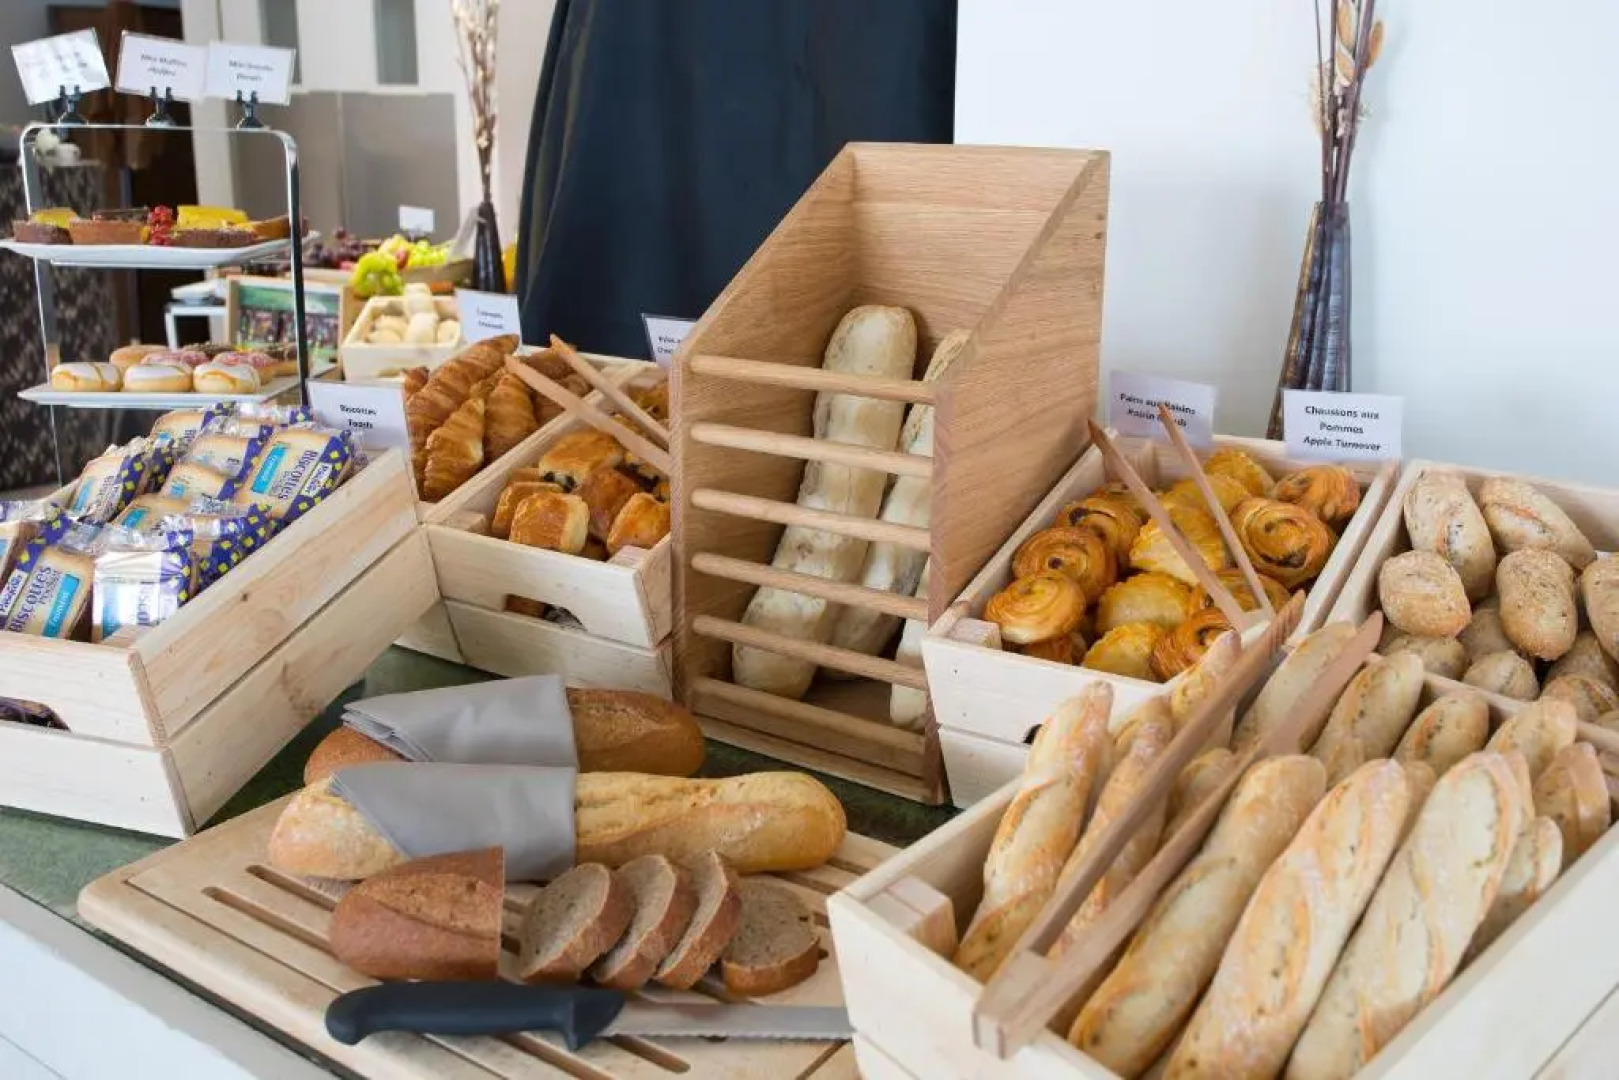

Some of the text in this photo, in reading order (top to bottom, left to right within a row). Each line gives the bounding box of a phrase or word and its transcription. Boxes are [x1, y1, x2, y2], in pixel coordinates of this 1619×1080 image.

[1305, 405, 1380, 420] Chaussons aux
[1319, 422, 1364, 434] Pommes
[1303, 436, 1381, 451] Apple Turnover
